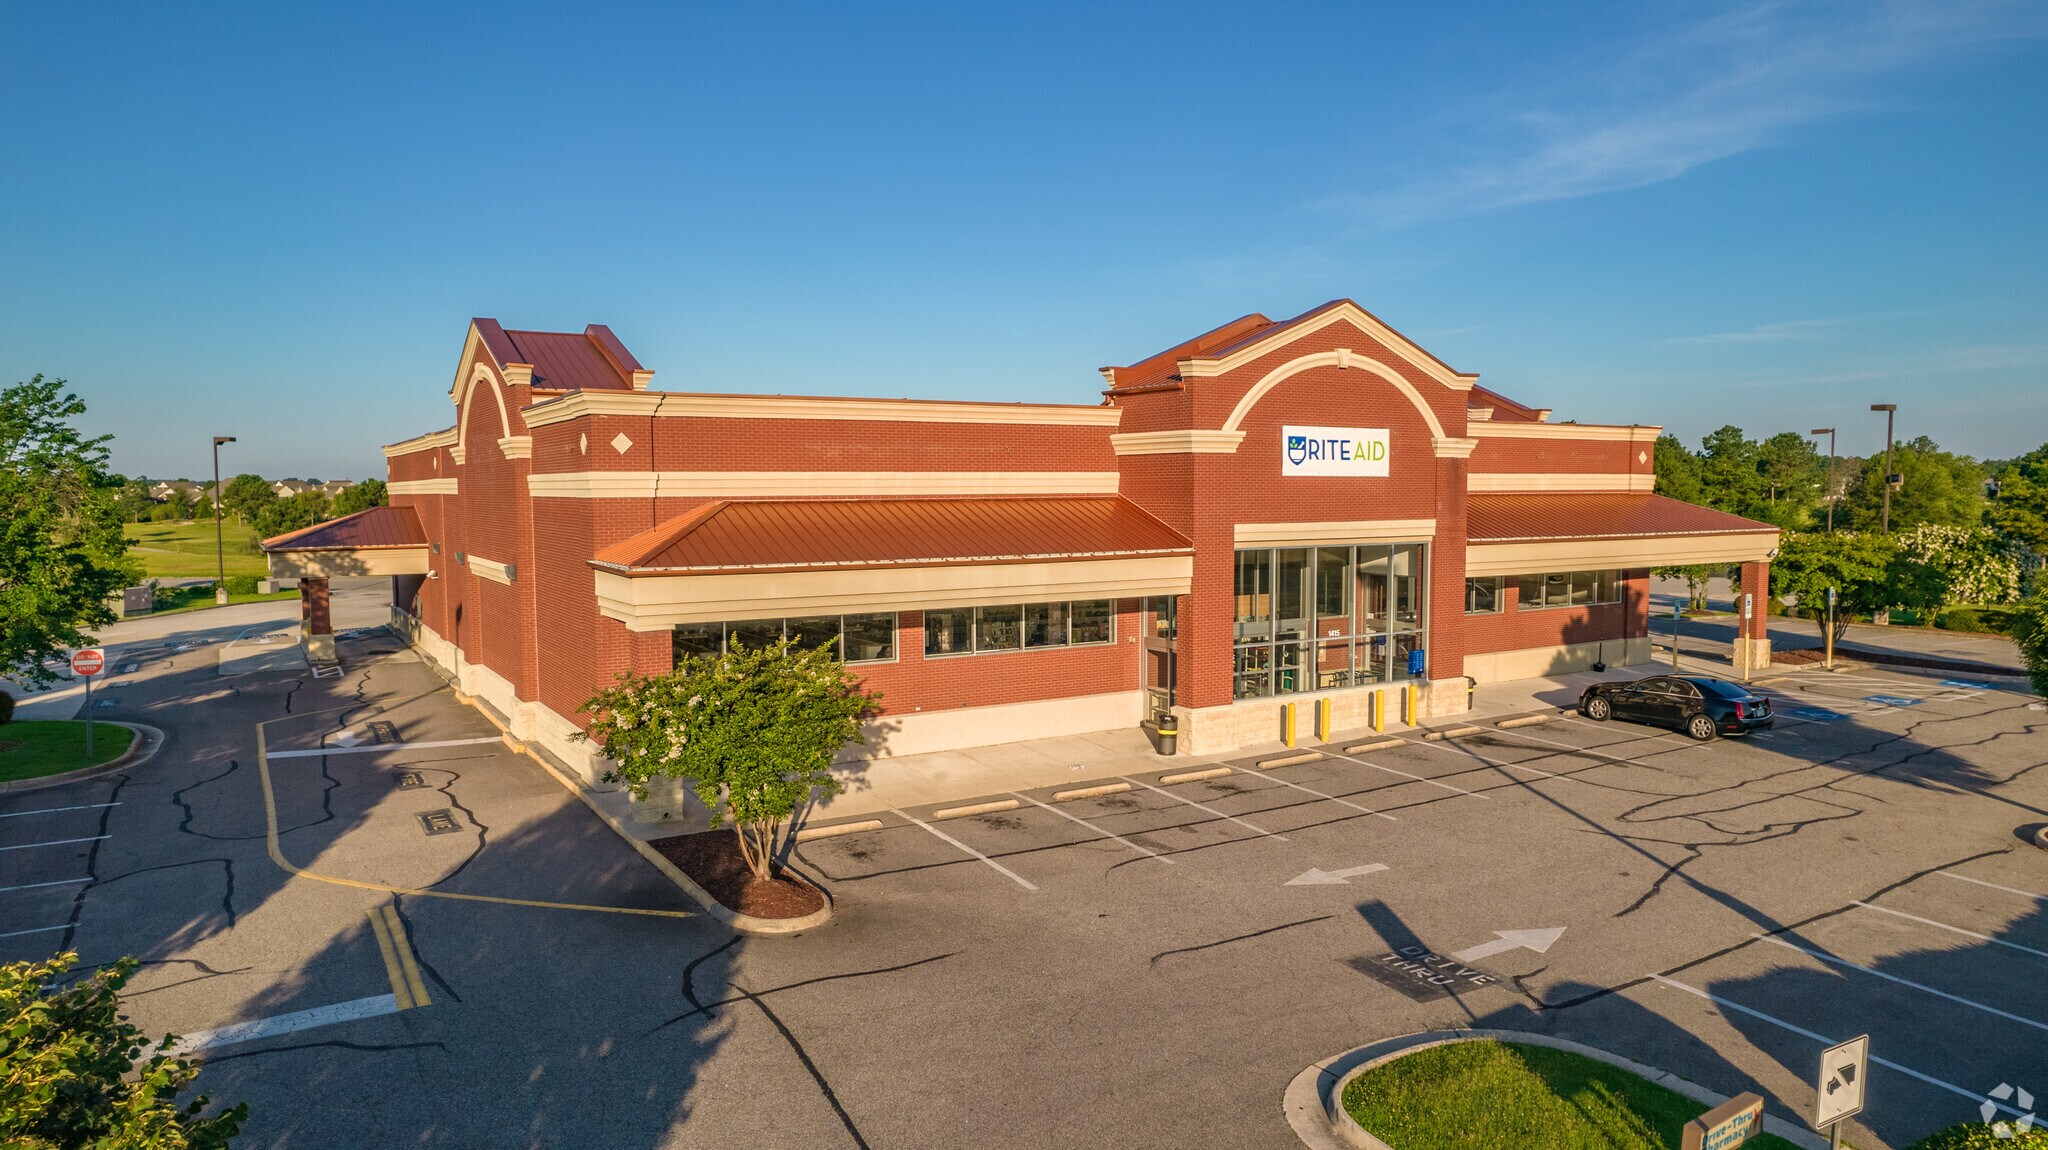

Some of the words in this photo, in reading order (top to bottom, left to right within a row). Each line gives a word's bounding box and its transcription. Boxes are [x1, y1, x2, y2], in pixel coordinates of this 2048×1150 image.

[1308, 438, 1351, 461] RITE
[1353, 440, 1385, 461] AID
[1328, 629, 1341, 637] 1415
[427, 813, 452, 831] LANE
[1382, 953, 1456, 985] THRU
[1399, 946, 1496, 986] DRIVE
[1702, 1110, 1754, 1144] Drive-Thru
